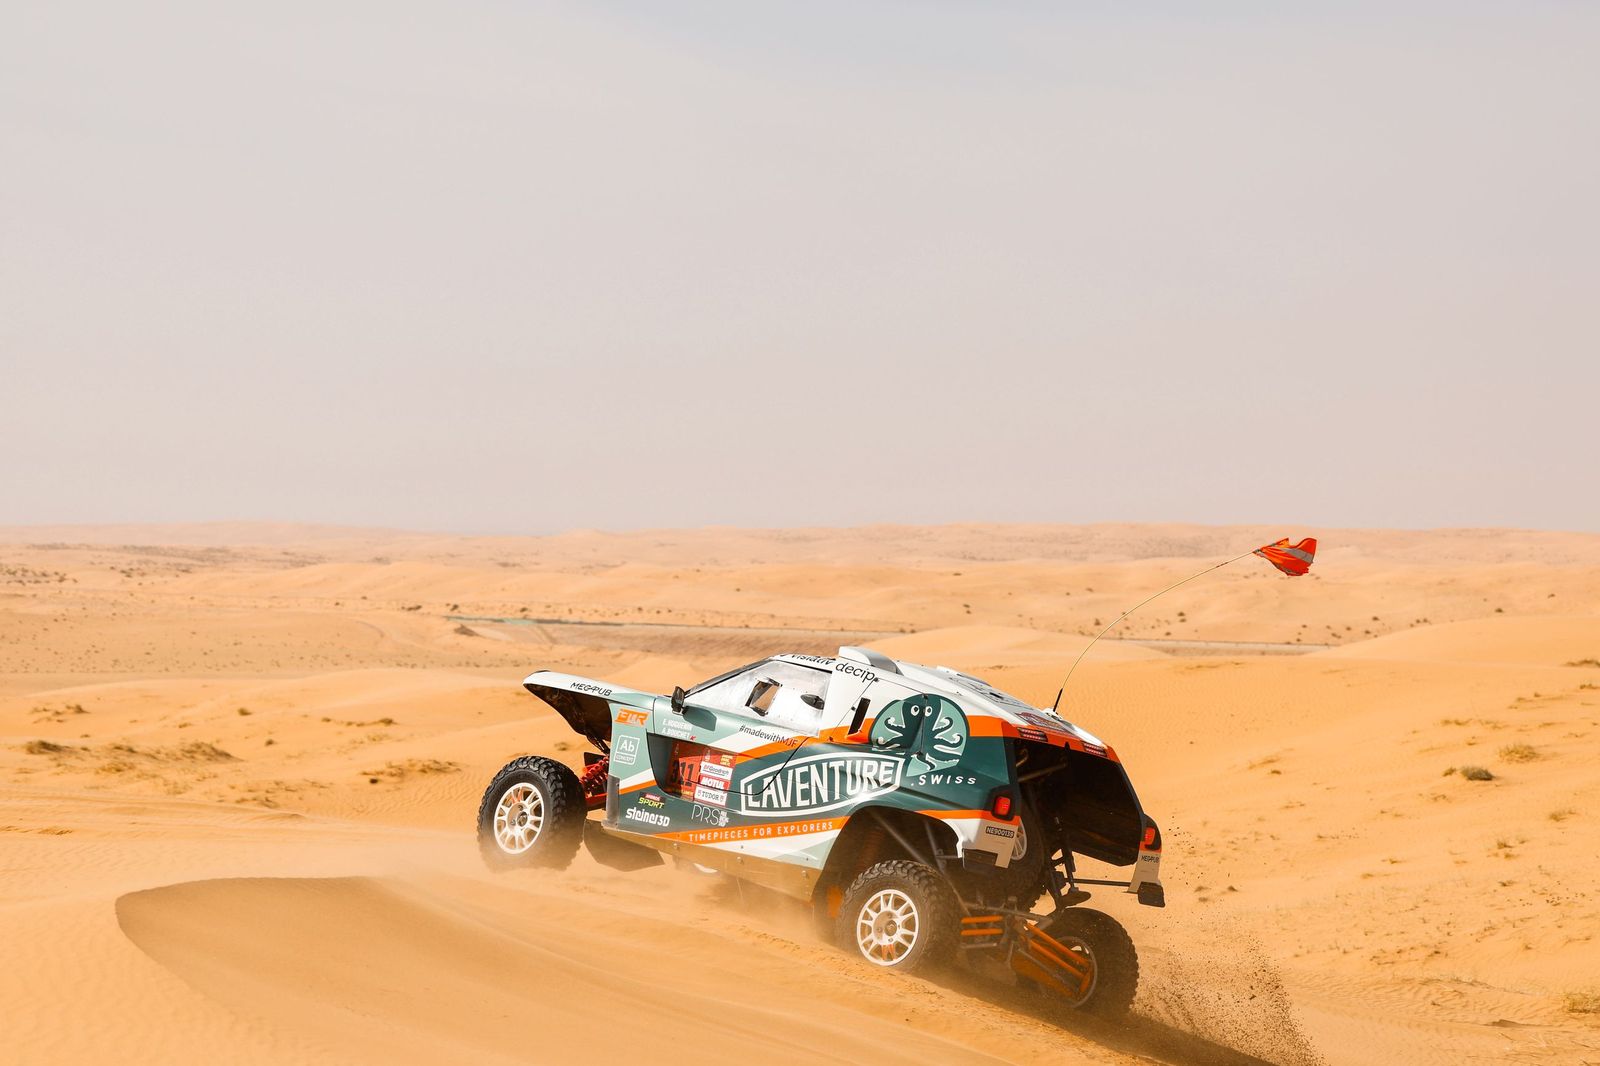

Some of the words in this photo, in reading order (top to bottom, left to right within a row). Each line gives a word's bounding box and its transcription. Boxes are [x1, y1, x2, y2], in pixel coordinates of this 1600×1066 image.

[739, 724, 798, 748] #madewithMJF
[620, 740, 635, 753] Ab
[701, 777, 725, 789] MOTUL
[702, 791, 719, 801] TUDOR
[638, 797, 664, 809] SPORT
[691, 804, 720, 826] PRS
[689, 828, 749, 842] TIMEPIECES
[753, 825, 772, 836] FOR
[777, 821, 834, 834] EXPLORERS
